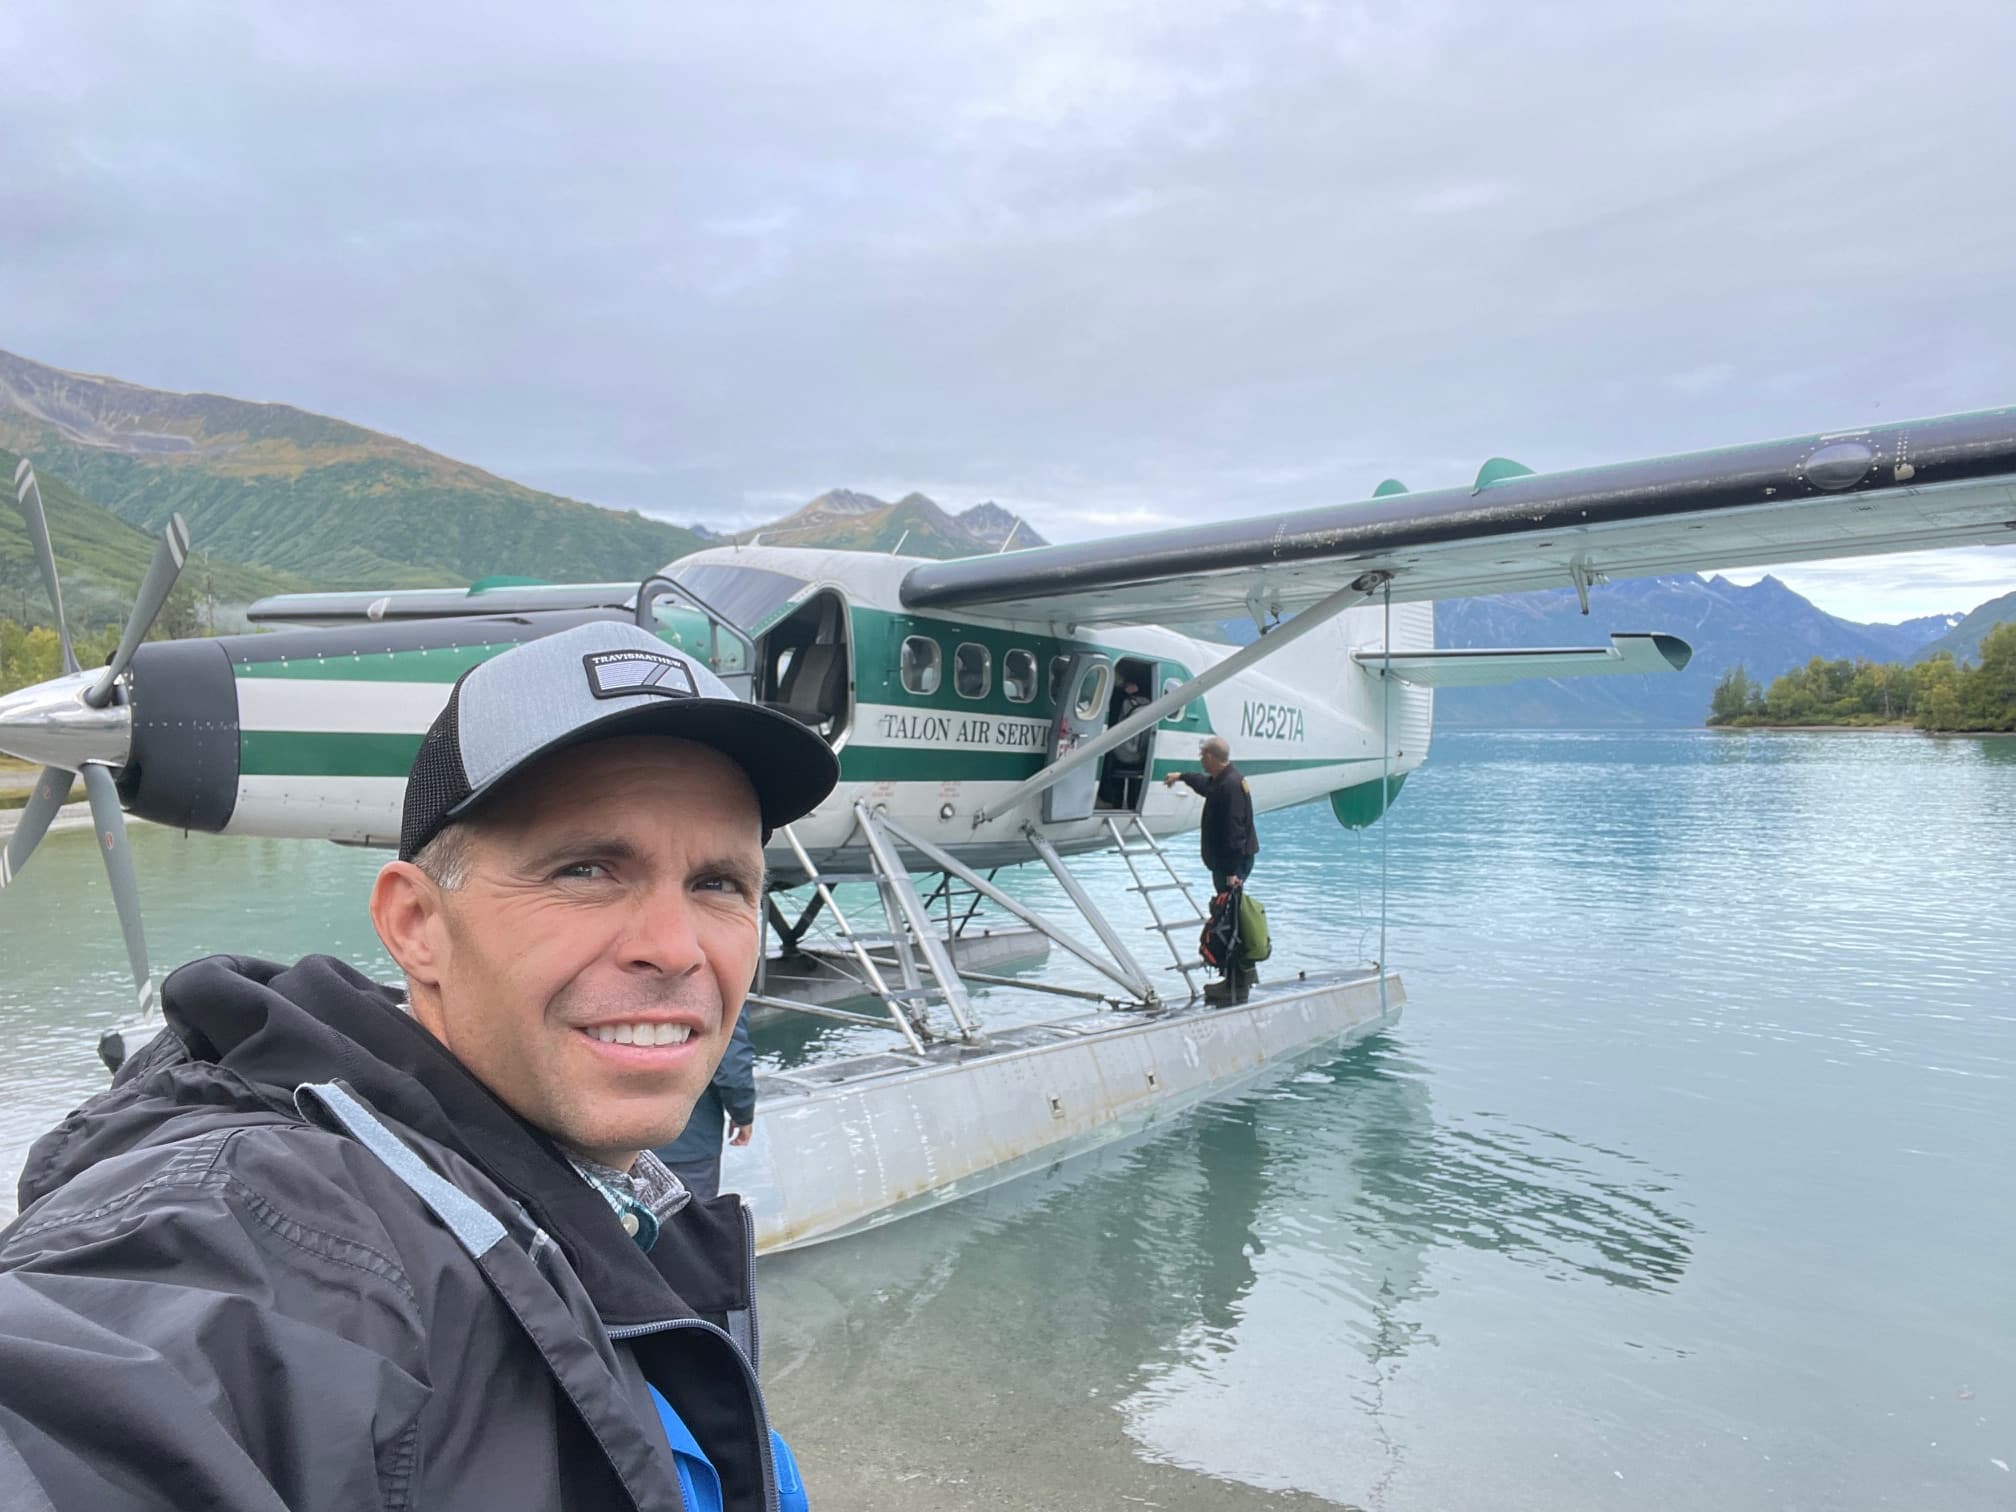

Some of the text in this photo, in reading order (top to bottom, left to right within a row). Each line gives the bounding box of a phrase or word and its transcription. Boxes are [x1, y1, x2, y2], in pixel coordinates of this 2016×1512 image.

[592, 653, 681, 667] TRAVISMATHEW
[884, 713, 1050, 747] TALON AIR SERVI
[1240, 700, 1304, 742] N252TA
